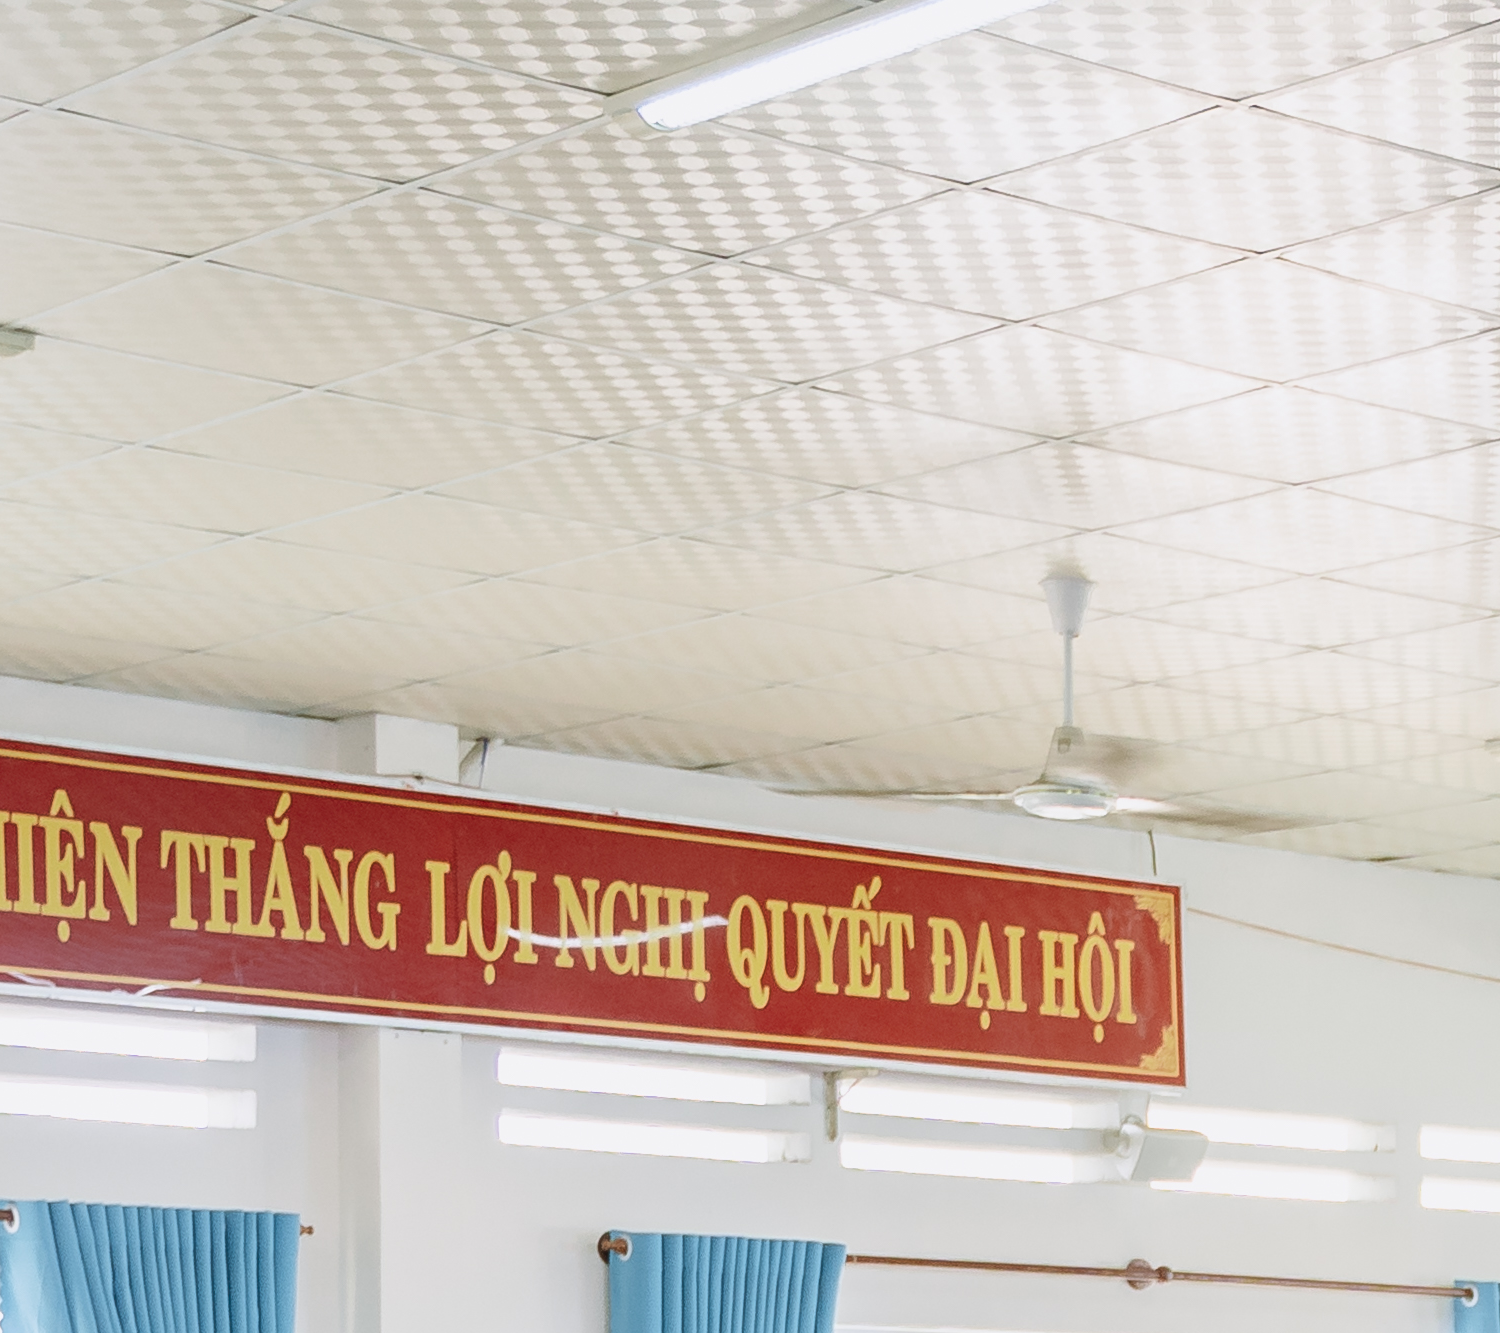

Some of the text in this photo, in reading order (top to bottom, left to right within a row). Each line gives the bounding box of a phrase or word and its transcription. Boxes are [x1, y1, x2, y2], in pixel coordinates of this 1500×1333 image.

[161, 791, 401, 950] THẮNG
[425, 850, 538, 985] LỢI
[554, 874, 711, 1003] NGHỊ
[726, 876, 915, 1009] QUYẾT
[928, 917, 1027, 1030] ĐẠI
[1038, 911, 1137, 1044] HỘI
